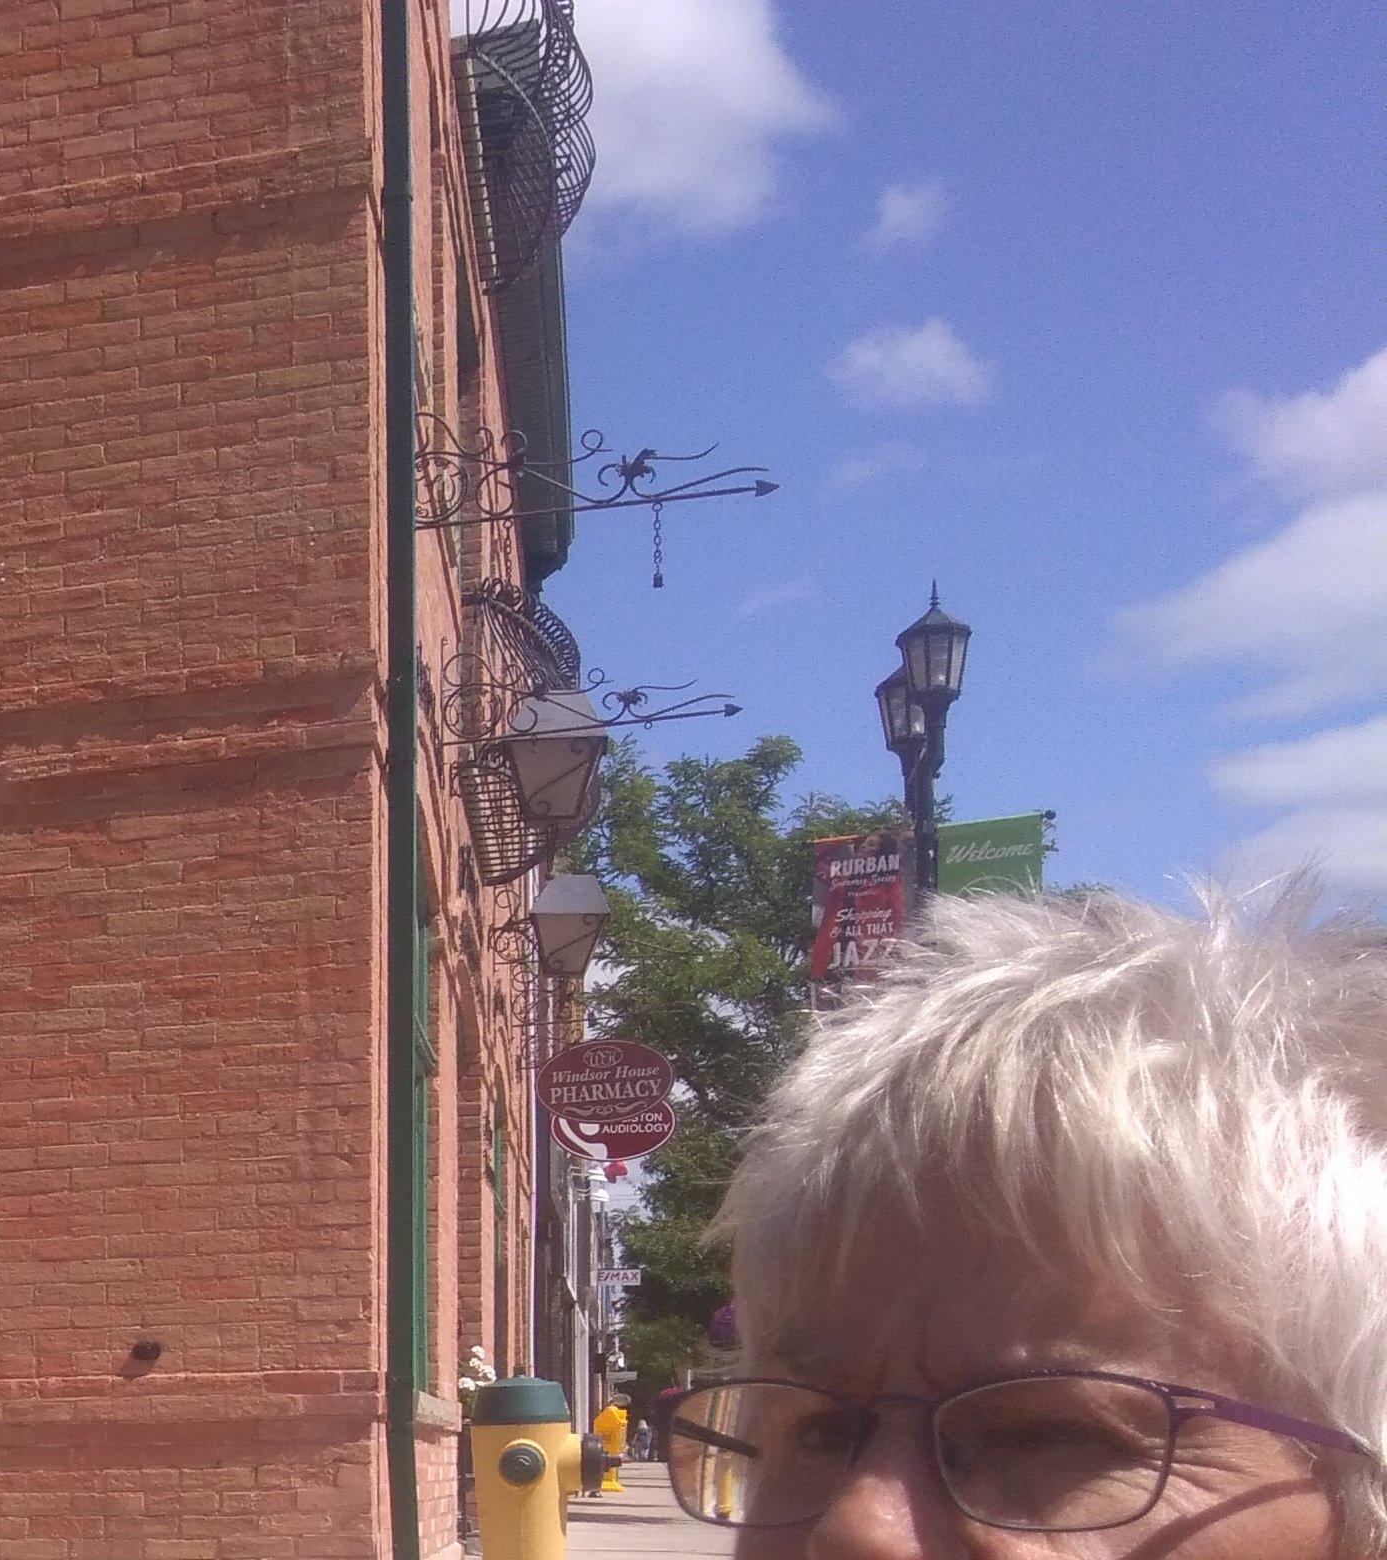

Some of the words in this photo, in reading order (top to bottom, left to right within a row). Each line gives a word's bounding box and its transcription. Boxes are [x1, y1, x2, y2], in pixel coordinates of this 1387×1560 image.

[946, 840, 1033, 863] Welcome
[829, 854, 900, 878] RURBAN
[834, 907, 893, 923] Shopping
[845, 924, 863, 937] ALL
[866, 922, 895, 935] THAT
[552, 1069, 611, 1084] Windsor
[614, 1065, 660, 1079] House
[550, 1079, 661, 1104] PHARMACY
[602, 1123, 670, 1134] AUDIOLOGY
